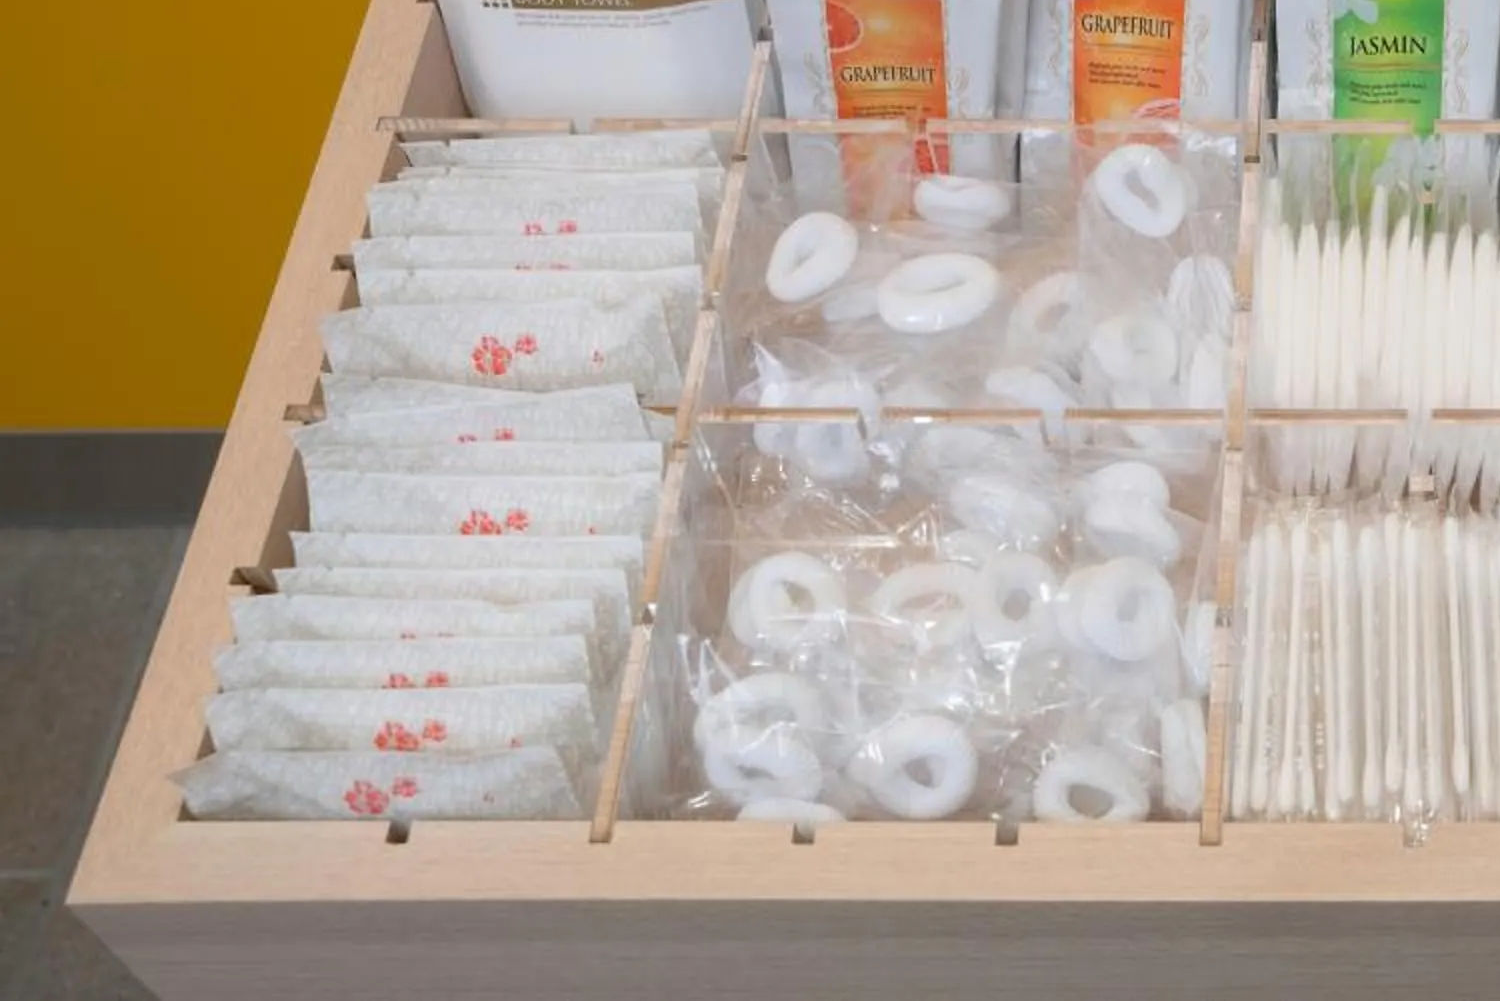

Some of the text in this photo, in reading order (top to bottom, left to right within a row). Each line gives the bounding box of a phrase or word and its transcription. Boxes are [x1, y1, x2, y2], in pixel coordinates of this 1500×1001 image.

[1081, 13, 1175, 40] GRAPEFRUIT
[1349, 35, 1428, 57] JASMIN
[840, 65, 936, 84] GRAPEFRUIT
